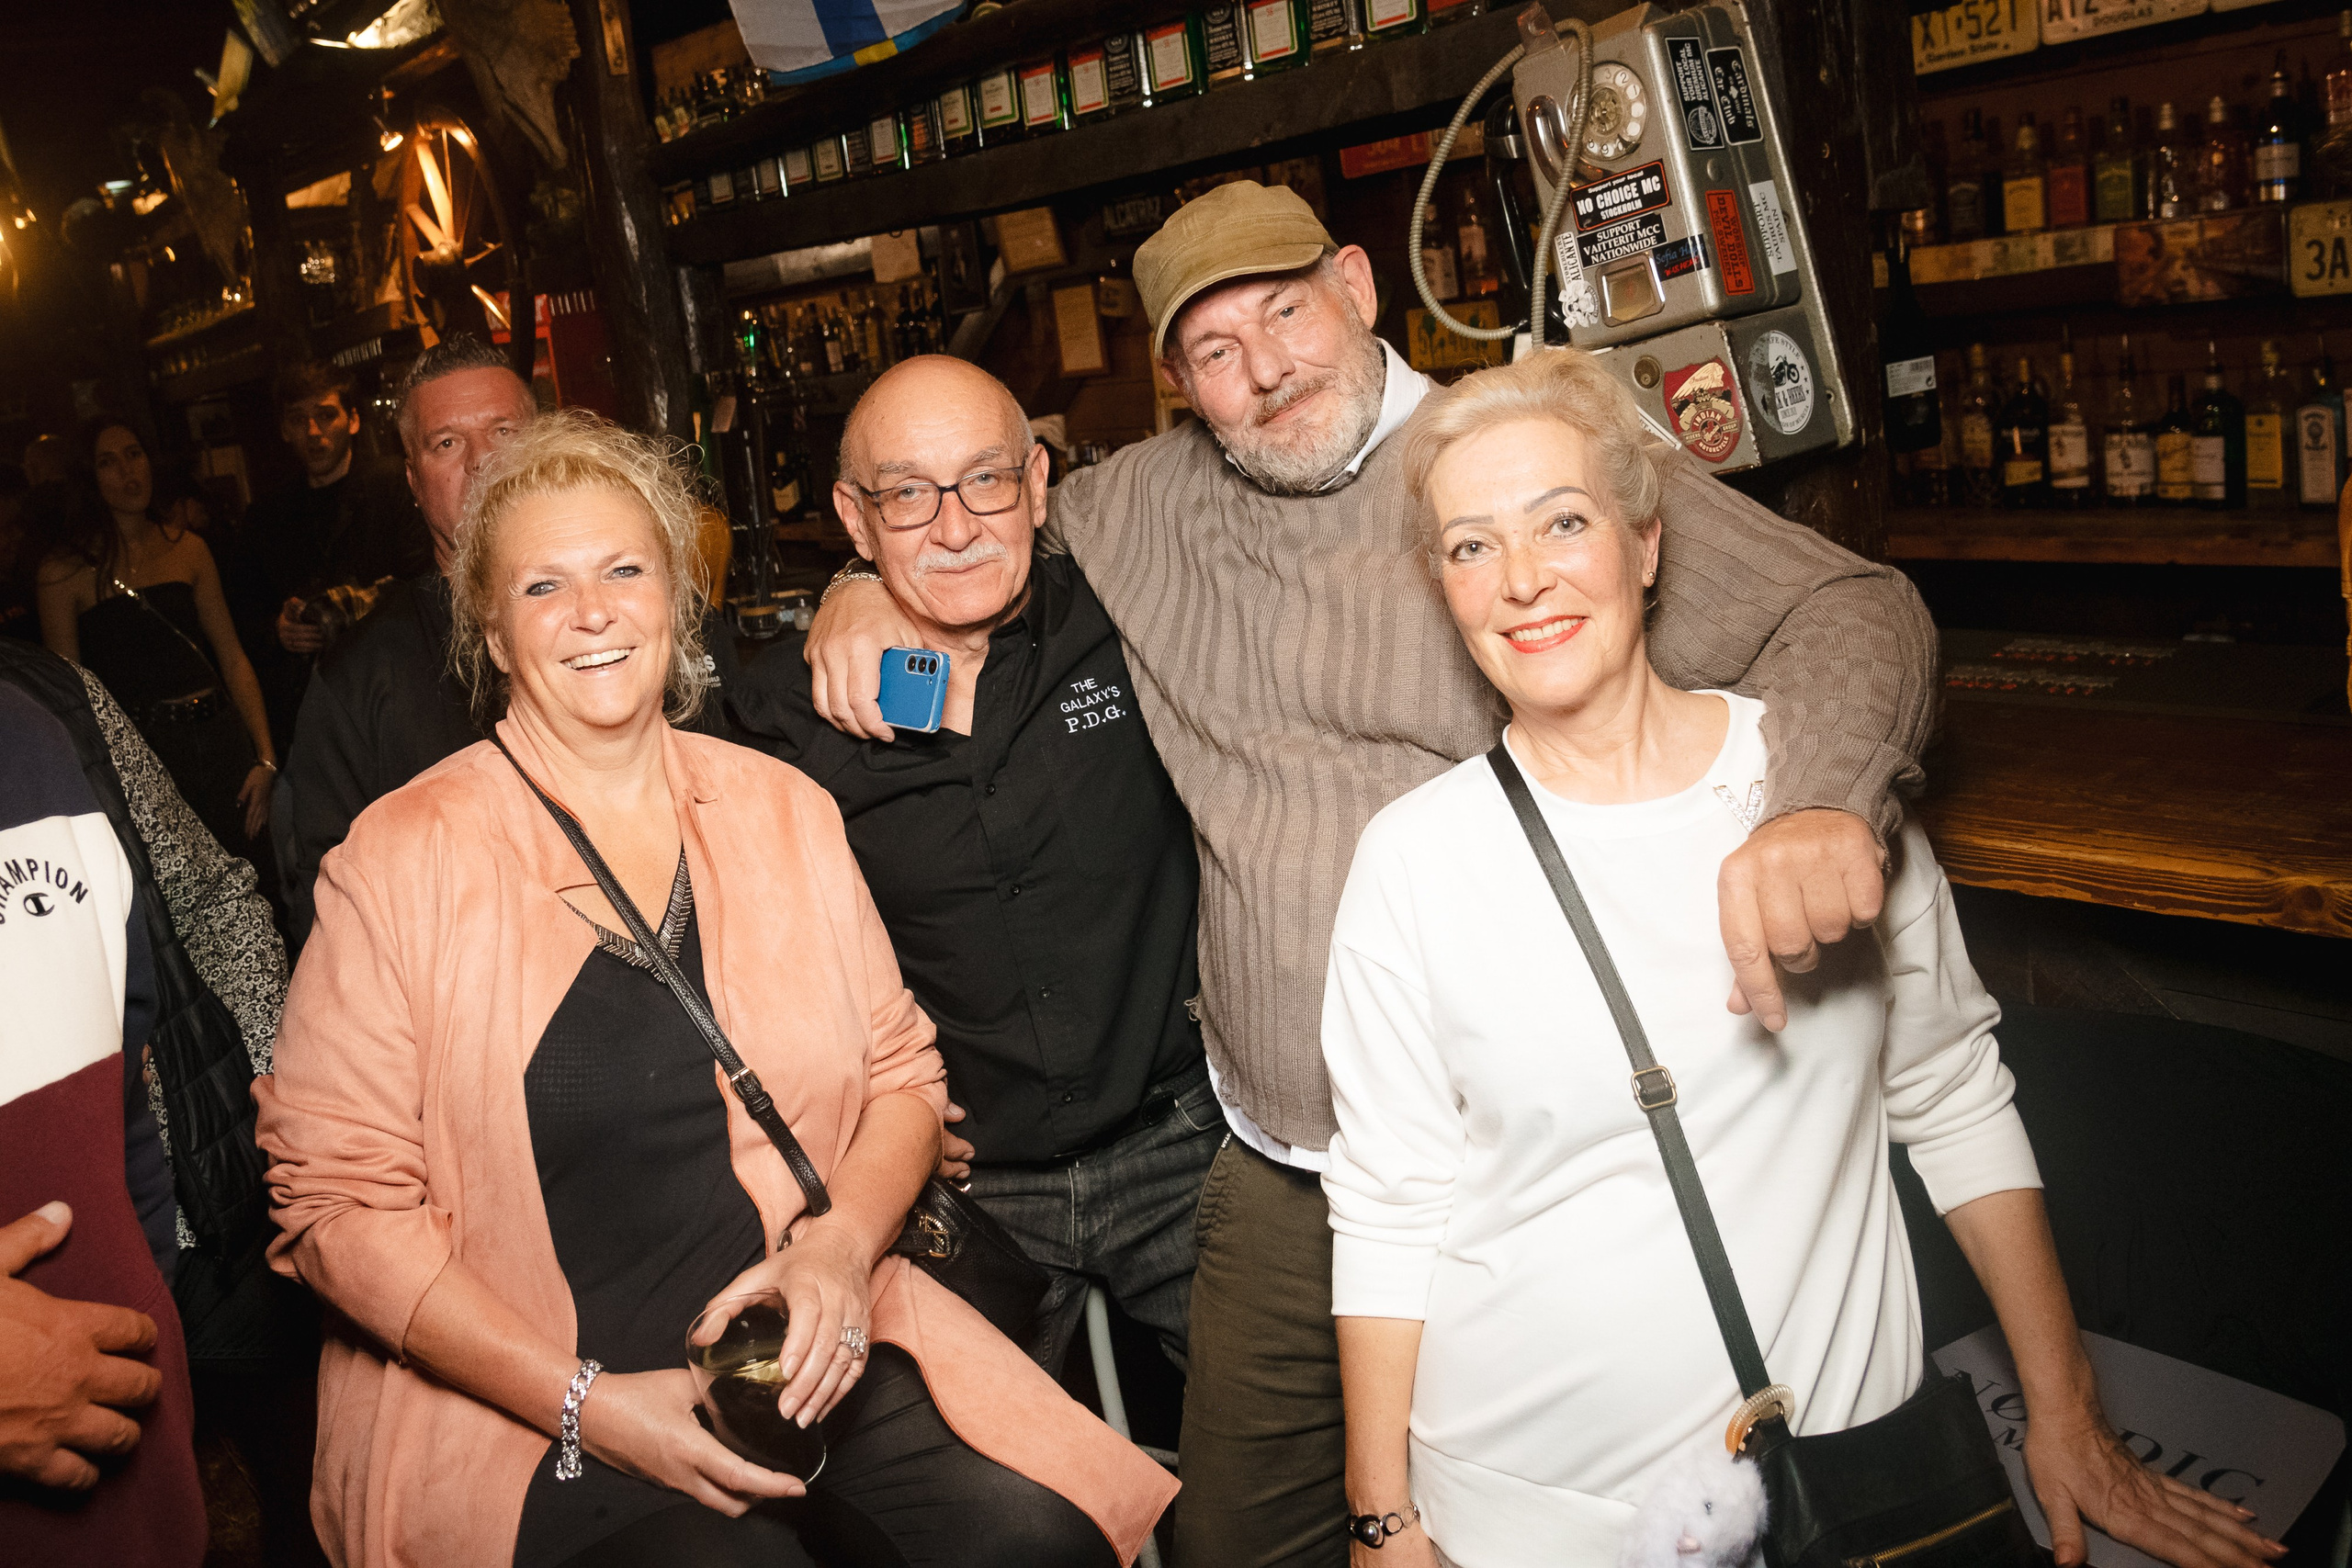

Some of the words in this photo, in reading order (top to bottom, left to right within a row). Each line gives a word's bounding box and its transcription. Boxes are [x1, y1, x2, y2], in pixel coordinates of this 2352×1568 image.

[1679, 48, 1690, 76] LOCAL
[1685, 42, 1693, 58] MC
[1620, 72, 1627, 84] 2
[1675, 61, 1690, 102] SUPPORT
[1686, 77, 1696, 102] YOUR
[1689, 60, 1703, 101] GREMIUM
[1694, 59, 1710, 101] ALICANTE
[1714, 66, 1724, 91] Car
[1720, 96, 1736, 125] Club
[1732, 60, 1755, 129] Cardinals
[1577, 197, 1594, 216] NO
[1596, 182, 1640, 209] CHOICE
[1641, 175, 1661, 196] MC
[1588, 181, 1612, 194] Support
[1612, 176, 1627, 186] your
[1627, 171, 1645, 180] local
[1600, 198, 1643, 220] STOCKHOLM
[1759, 192, 1770, 212] MC
[1597, 219, 1642, 243] SUPPORT
[1713, 209, 1722, 227] MC
[1753, 201, 1775, 258] SUPPORT
[1772, 209, 1786, 243] SPAIN
[1583, 230, 1637, 256] VAITTERIT
[1638, 223, 1661, 243] MCC
[1591, 235, 1657, 265] NATIONWIDE
[1717, 196, 1733, 237] DEVIL
[1727, 243, 1744, 288] DOLLS
[1717, 229, 1732, 276] SWEDEN
[1731, 216, 1746, 267] WORSHIP
[1766, 215, 1782, 264] TAURUS
[1563, 233, 1581, 281] ALICANTE
[1693, 409, 1722, 427] INDIAN
[1723, 423, 1737, 432] GROUP
[1699, 435, 1729, 453] MOTORCYCLE
[1060, 686, 1121, 713] GALAXY'S
[1070, 678, 1098, 694] THE
[1065, 705, 1126, 733] P.D.G.
